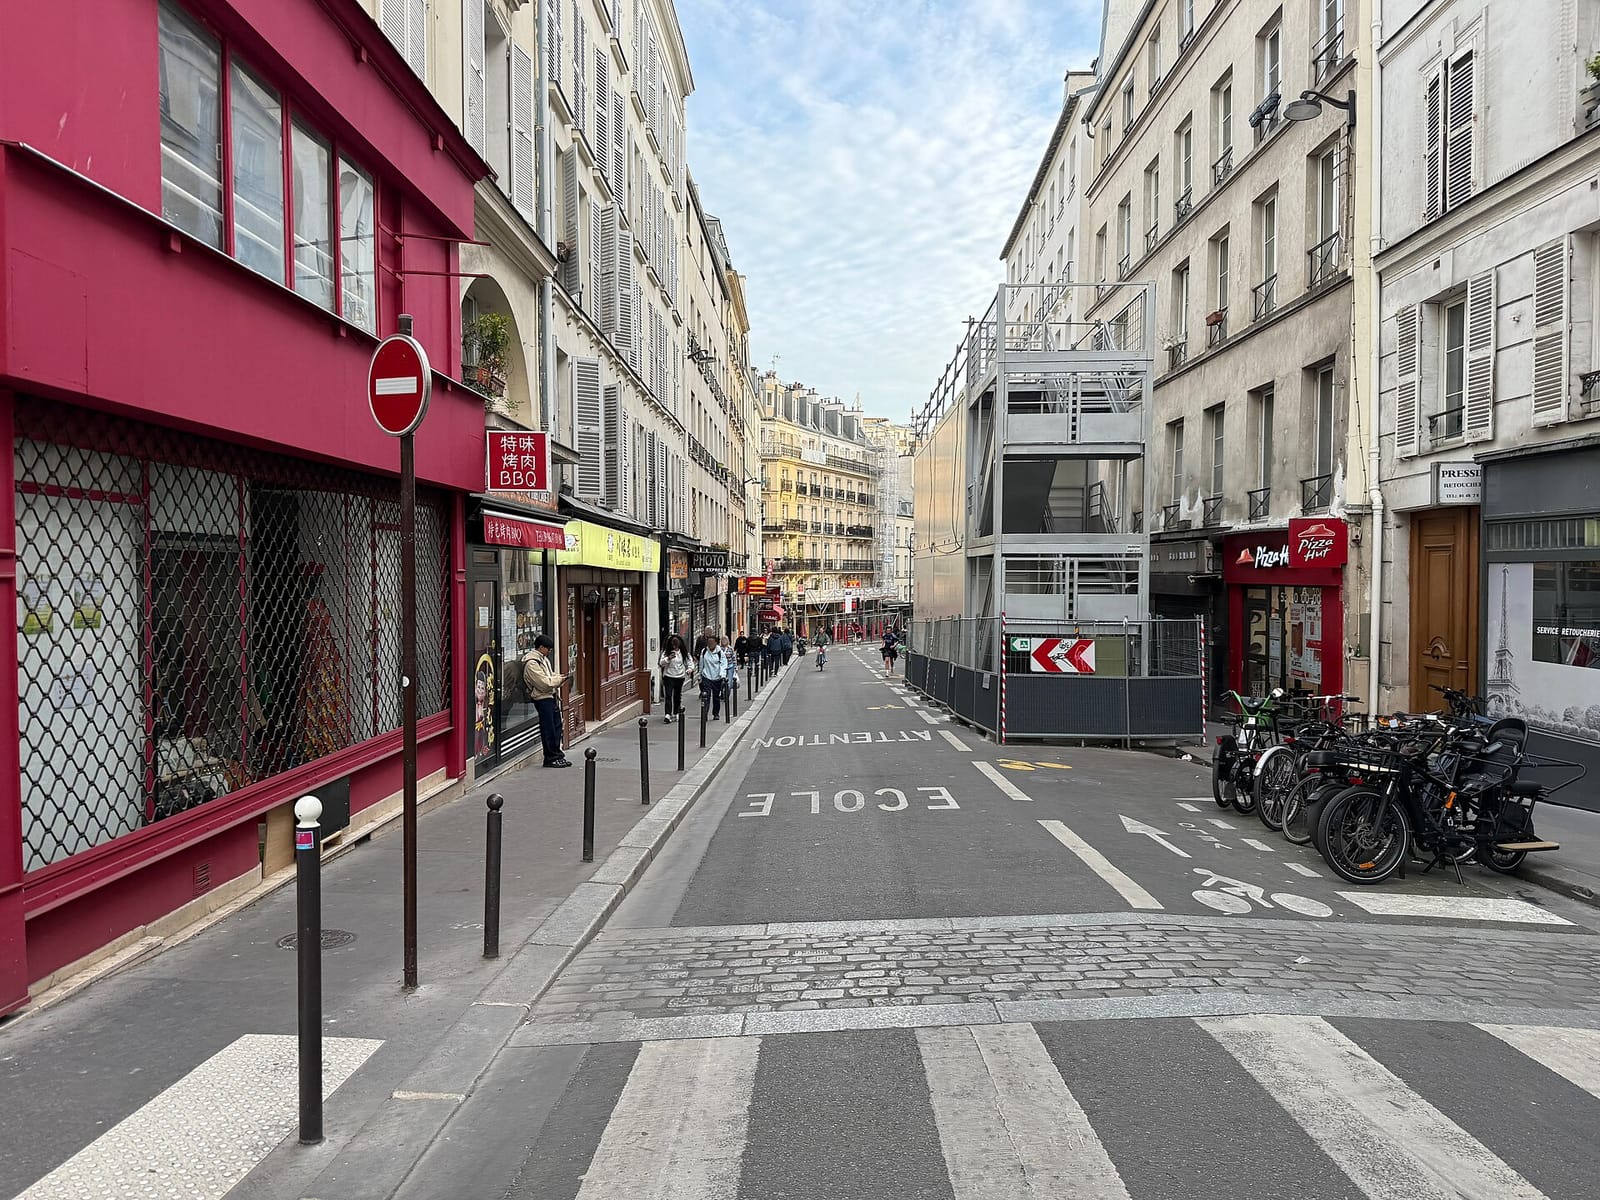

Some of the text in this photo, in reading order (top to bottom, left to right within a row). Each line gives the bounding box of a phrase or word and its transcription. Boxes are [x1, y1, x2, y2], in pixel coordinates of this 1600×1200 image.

[500, 435, 535, 452] 特味
[501, 453, 536, 470] 烤肉
[500, 471, 537, 487] BBQ
[1297, 537, 1333, 554] Pizza
[693, 554, 725, 567] PHOTO
[1254, 545, 1279, 568] Pizza
[1304, 548, 1332, 562] Hut
[1536, 626, 1600, 638] SERVICE RETOUCHERIE
[750, 729, 932, 750] ATTENTION
[738, 786, 960, 817] ECOLE
